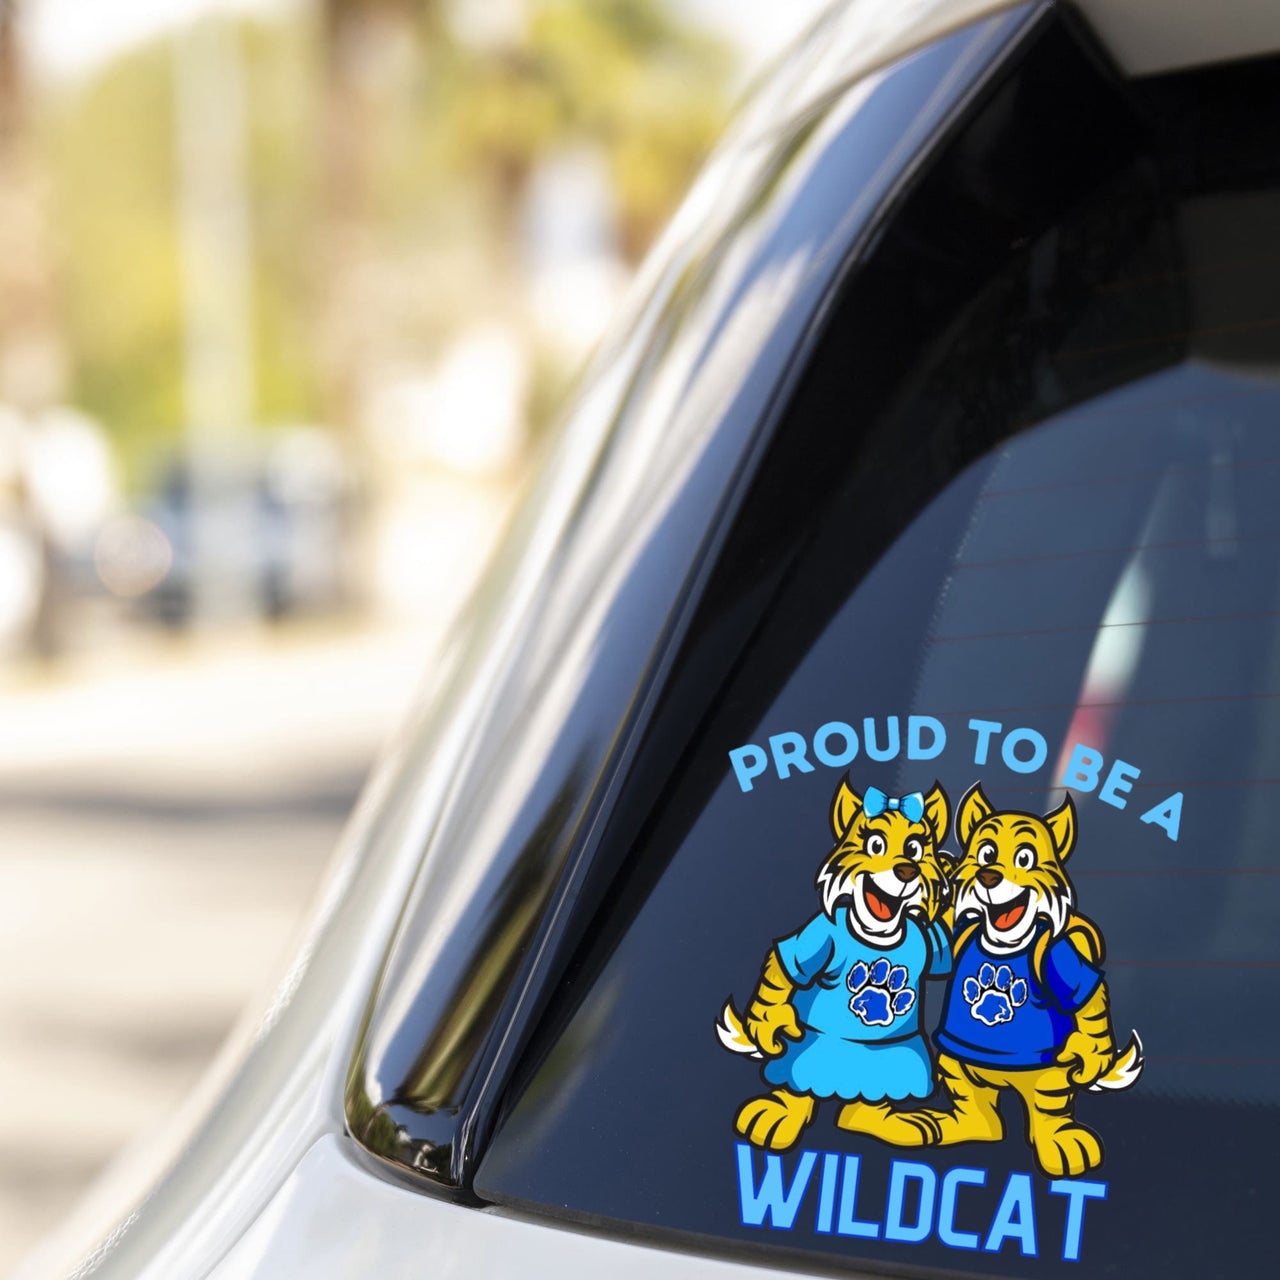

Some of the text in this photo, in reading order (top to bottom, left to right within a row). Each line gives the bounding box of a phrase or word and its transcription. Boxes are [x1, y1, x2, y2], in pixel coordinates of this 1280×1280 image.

[728, 715, 1184, 842] PROUD TO BE A
[733, 1142, 1109, 1263] WILDCAT
